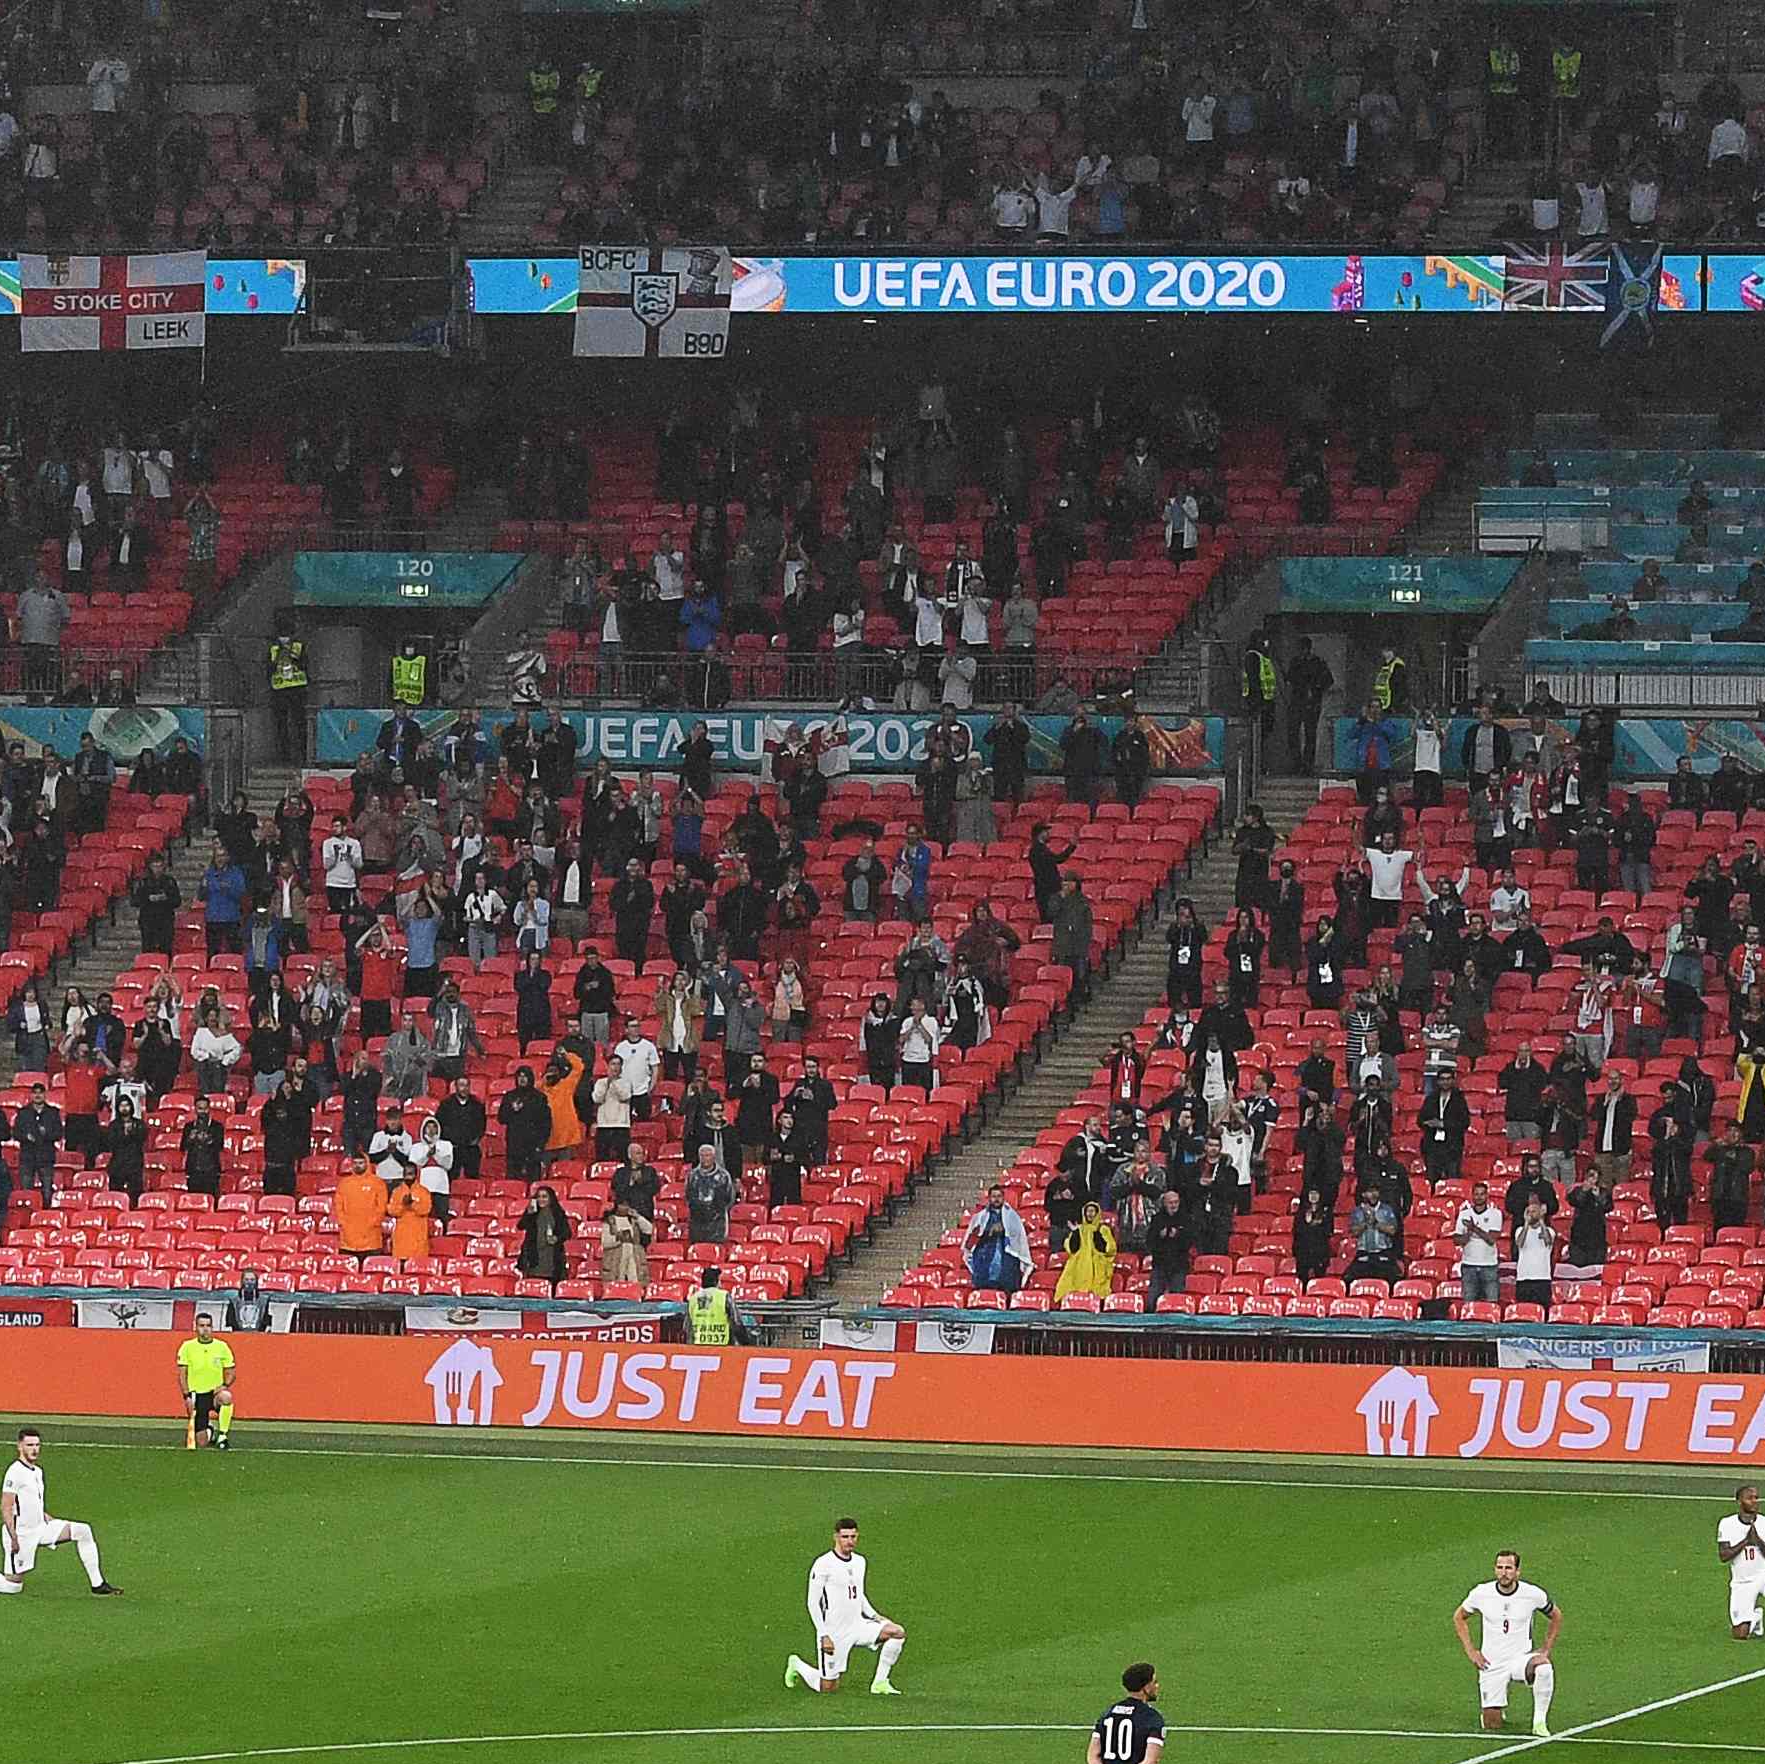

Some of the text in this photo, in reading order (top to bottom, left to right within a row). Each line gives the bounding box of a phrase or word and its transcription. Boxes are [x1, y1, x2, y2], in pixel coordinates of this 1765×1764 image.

[581, 249, 636, 271] BCFC
[834, 261, 1285, 306] UEFA EURO 2020
[53, 292, 174, 311] STOKE CITY
[143, 320, 189, 341] LEEK
[396, 560, 433, 577] 120
[1388, 565, 1423, 581] 121
[522, 1350, 896, 1429] JUST EAT
[1459, 1379, 1670, 1458] JUST
[1744, 1545, 1755, 1561] 10
[847, 1585, 858, 1600] 19
[1502, 1619, 1510, 1634] 9
[1102, 1716, 1133, 1761] 10
